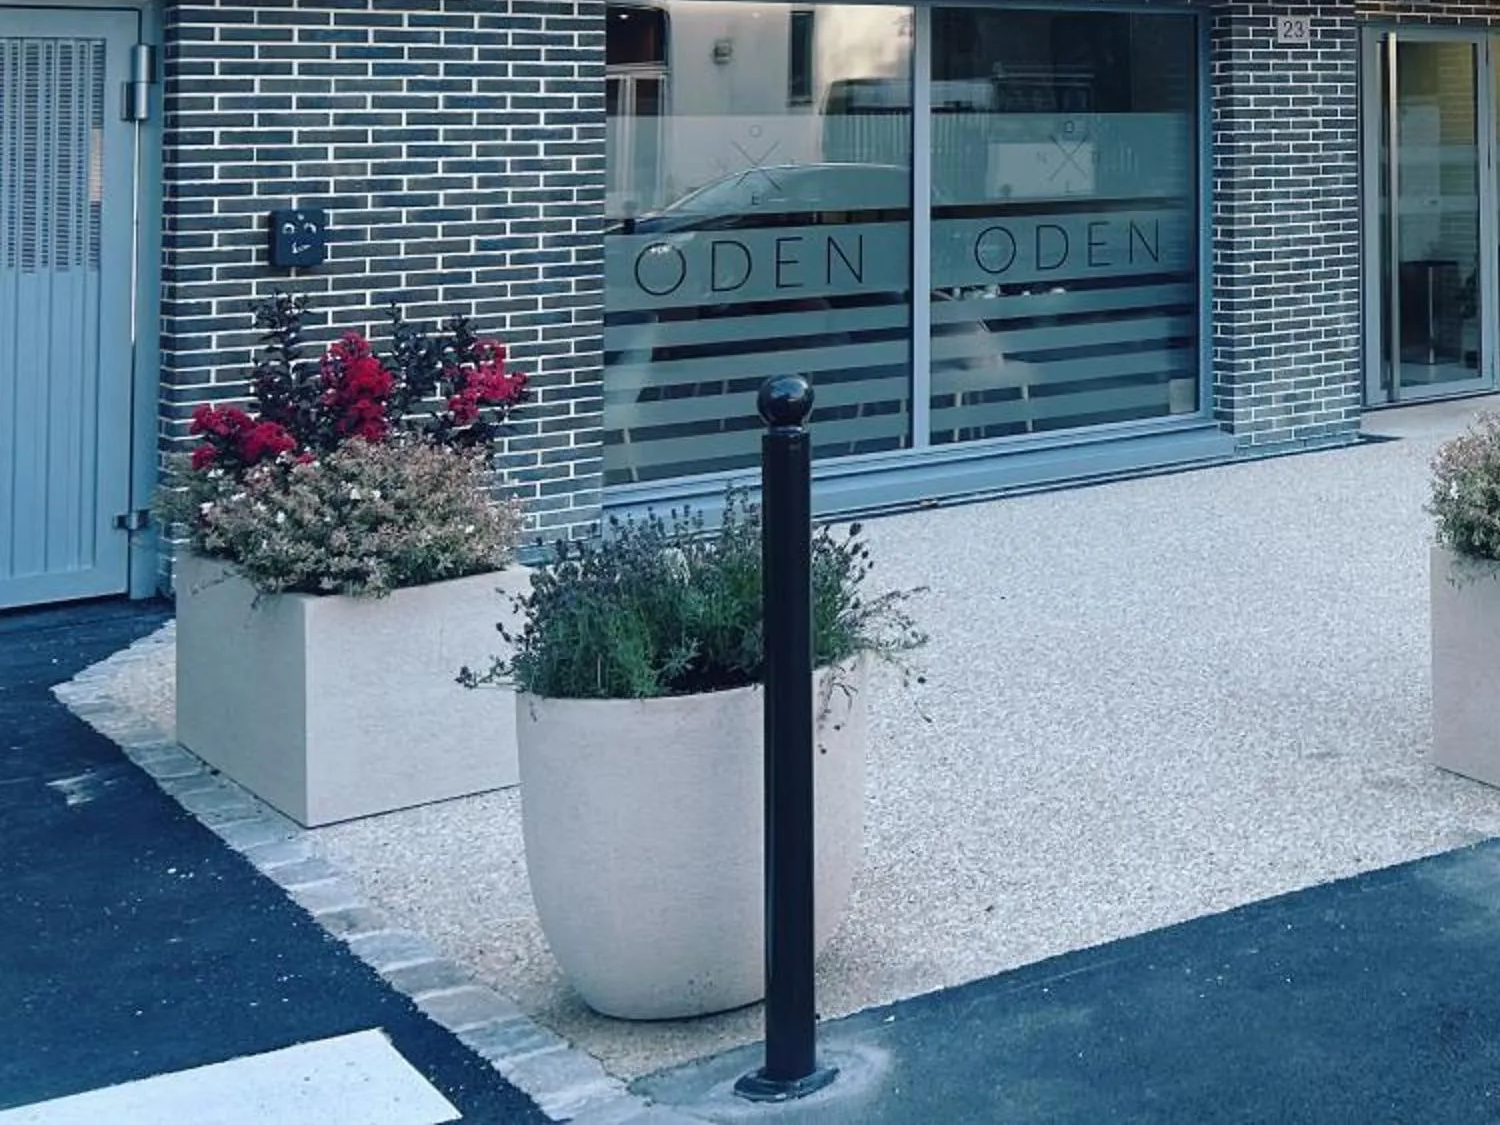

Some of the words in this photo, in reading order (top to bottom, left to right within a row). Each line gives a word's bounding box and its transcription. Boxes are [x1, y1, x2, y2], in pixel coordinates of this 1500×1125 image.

[1283, 20, 1305, 38] 23
[633, 234, 864, 296] ODEN
[973, 219, 1160, 274] ODEN
